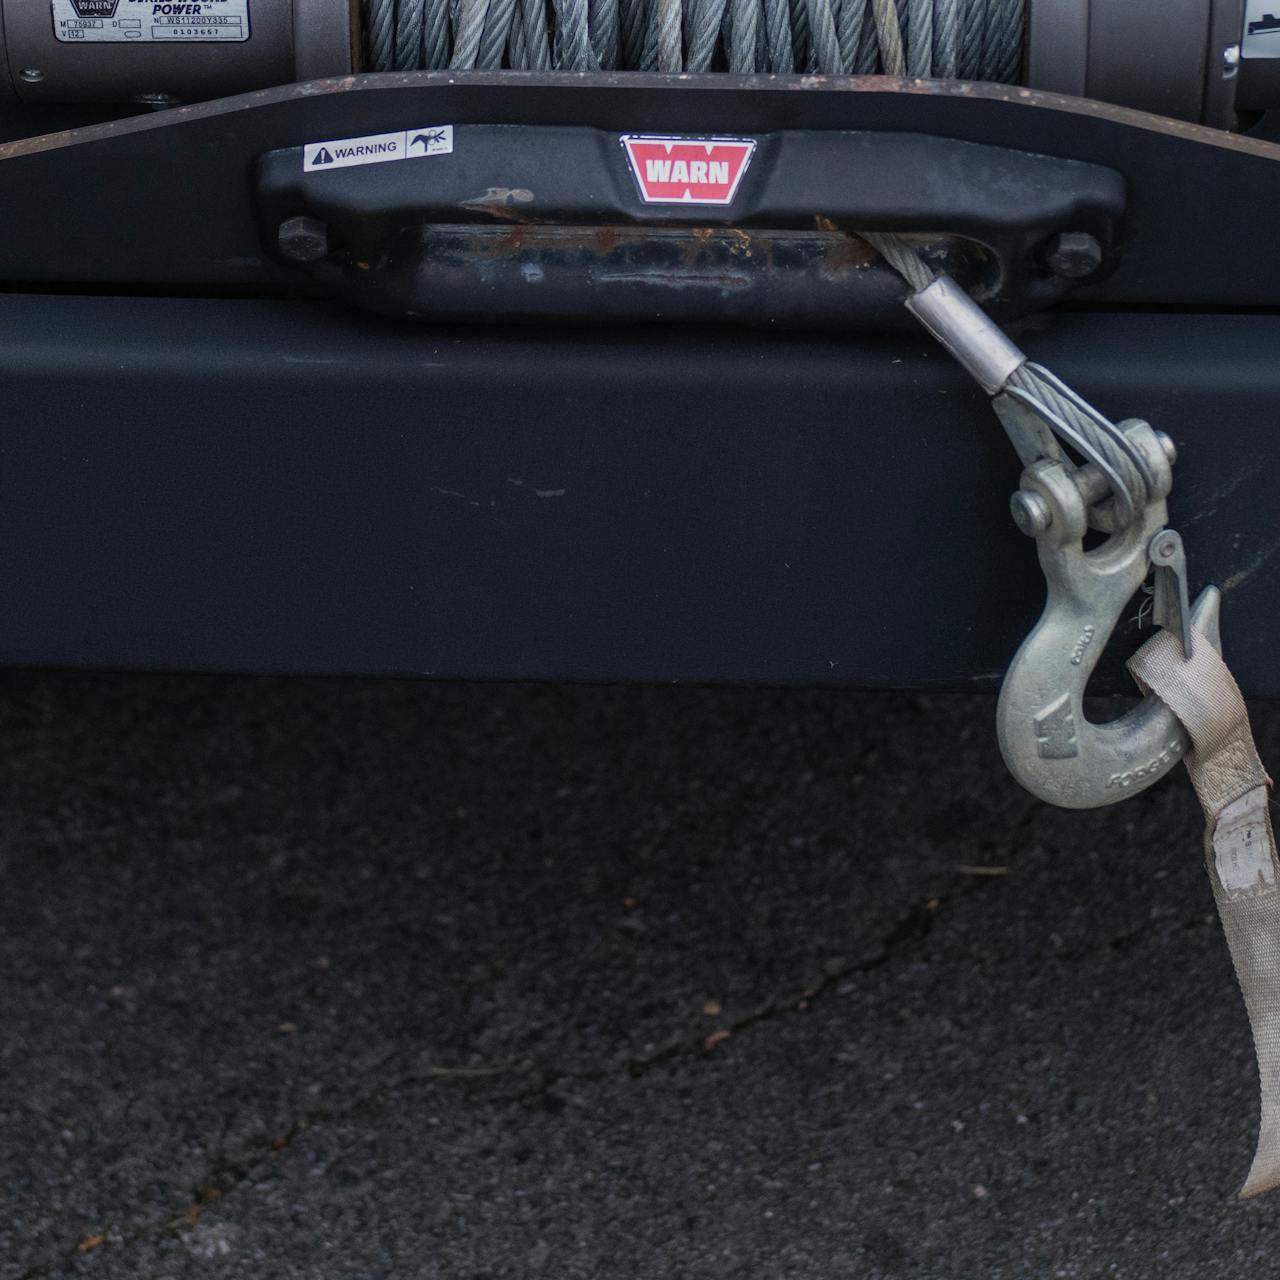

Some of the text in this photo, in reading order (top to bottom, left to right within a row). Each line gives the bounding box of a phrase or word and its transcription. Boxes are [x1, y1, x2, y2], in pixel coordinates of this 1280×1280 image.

[78, 1, 112, 10] WARN
[152, 4, 201, 15] POWER
[334, 141, 397, 159] WARNING
[645, 159, 729, 185] WARN
